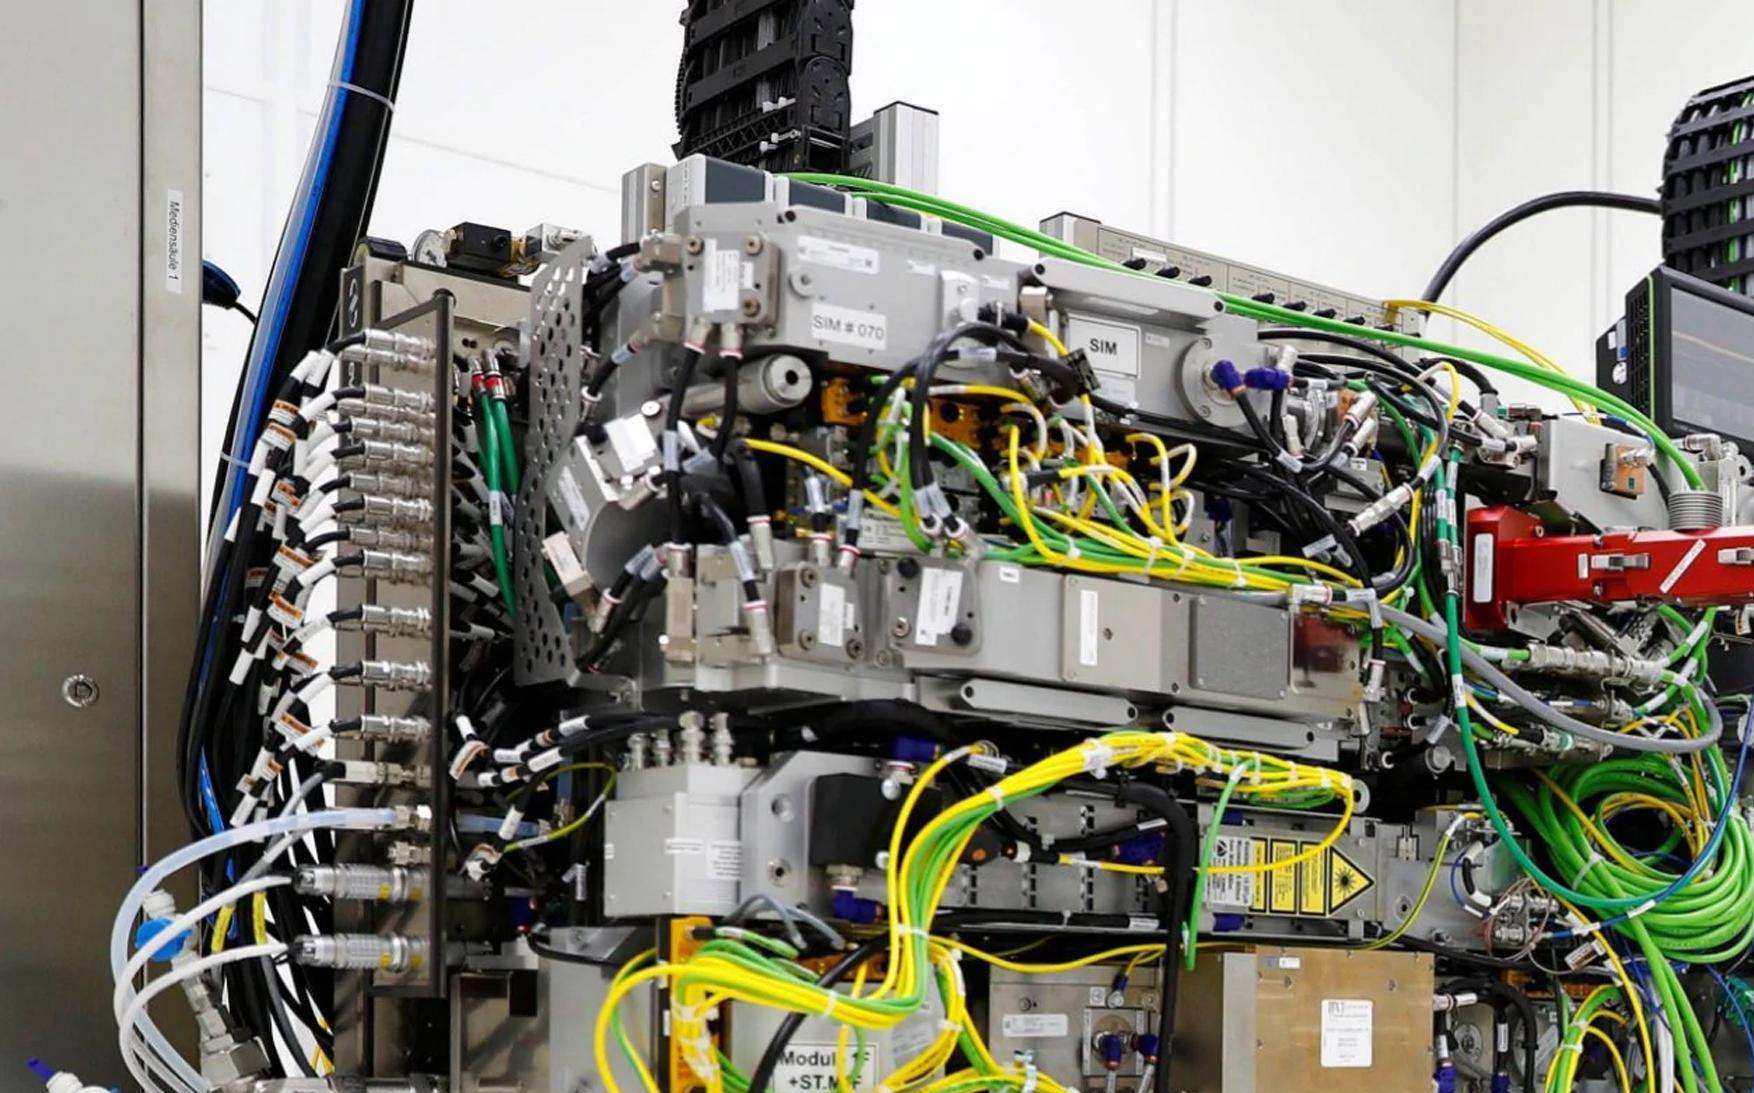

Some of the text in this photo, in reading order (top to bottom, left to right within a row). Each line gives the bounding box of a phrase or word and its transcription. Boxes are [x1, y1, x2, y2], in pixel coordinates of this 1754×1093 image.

[813, 314, 841, 333] SIM
[858, 323, 885, 341] 070
[1089, 338, 1117, 355] SIM
[781, 1051, 841, 1067] Modul
[789, 1074, 862, 1091] +ST.MF
